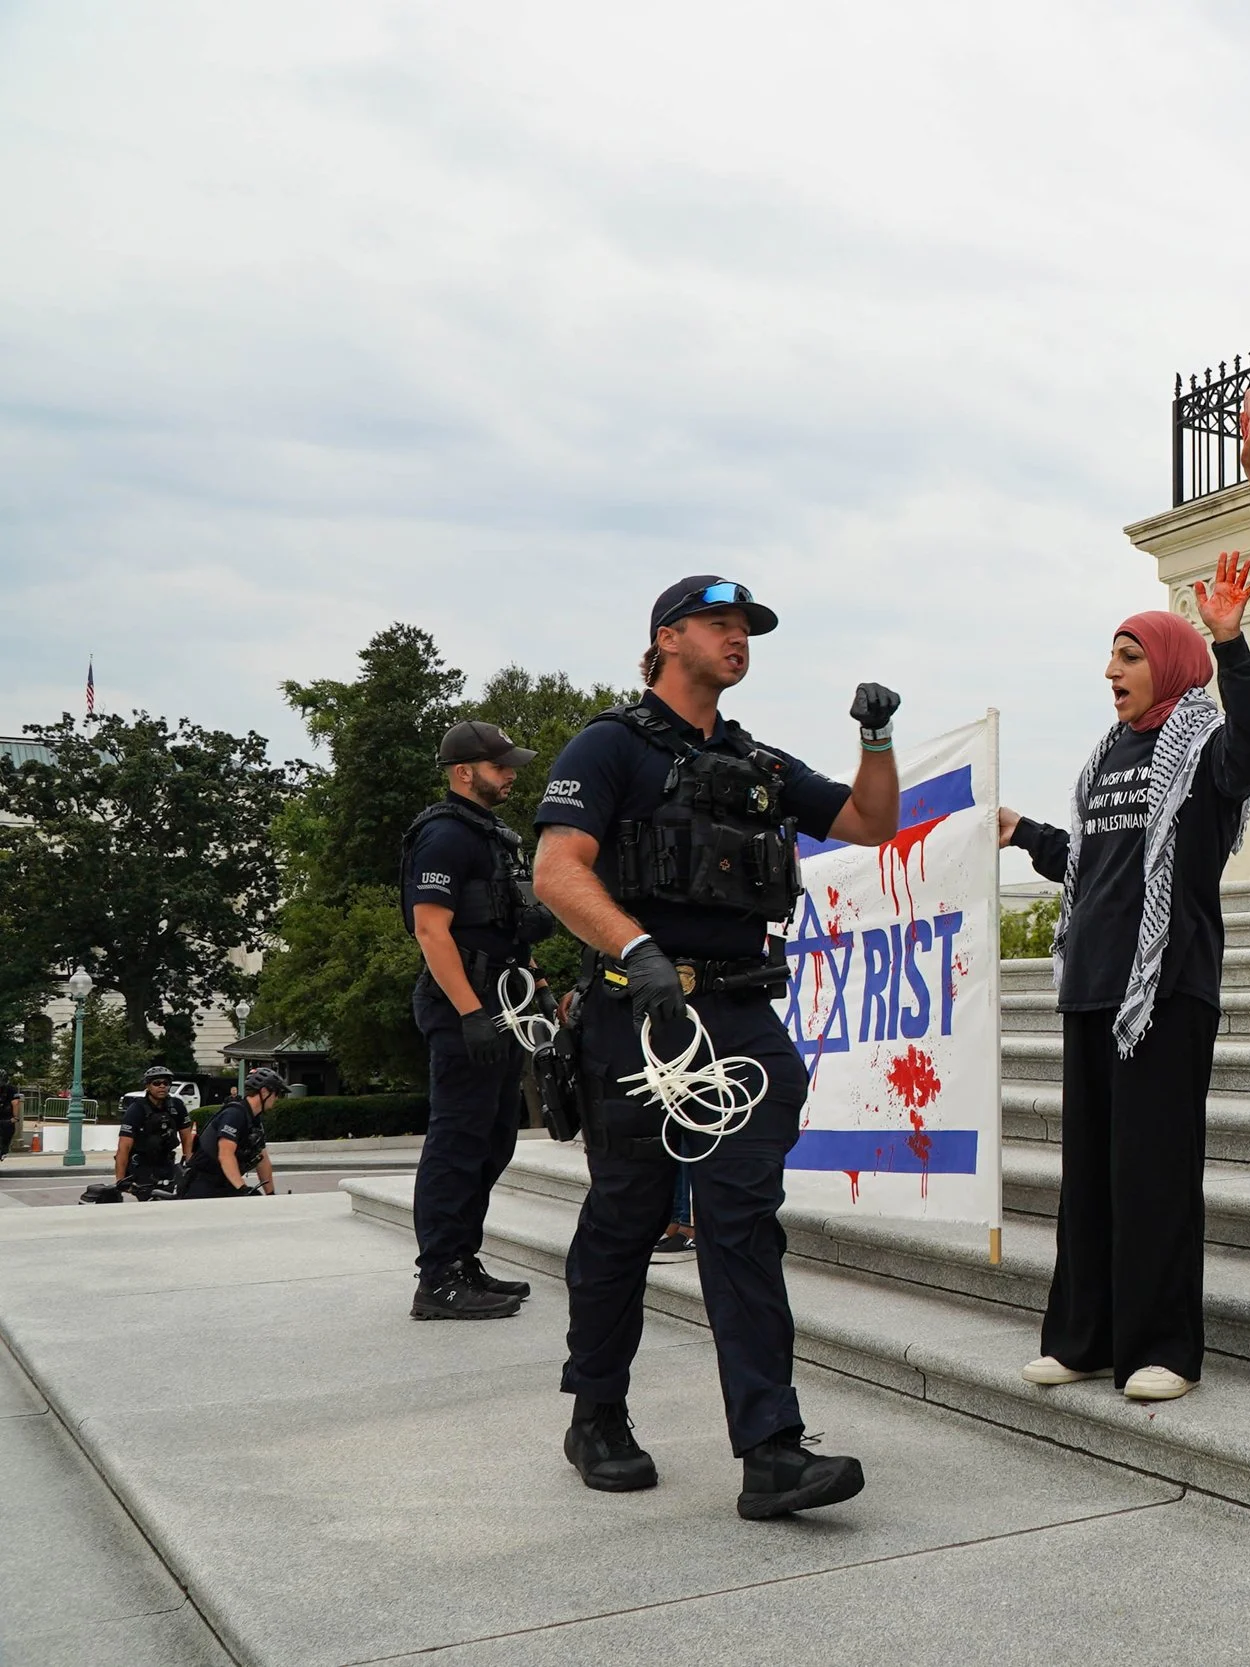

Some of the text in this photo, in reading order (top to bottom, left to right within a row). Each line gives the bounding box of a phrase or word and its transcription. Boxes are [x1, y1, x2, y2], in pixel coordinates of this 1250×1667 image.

[543, 779, 581, 798] SCP
[1088, 793, 1110, 810] WHAT
[1110, 791, 1128, 807] YOU
[1084, 819, 1096, 835] FOR
[421, 872, 451, 886] USCP
